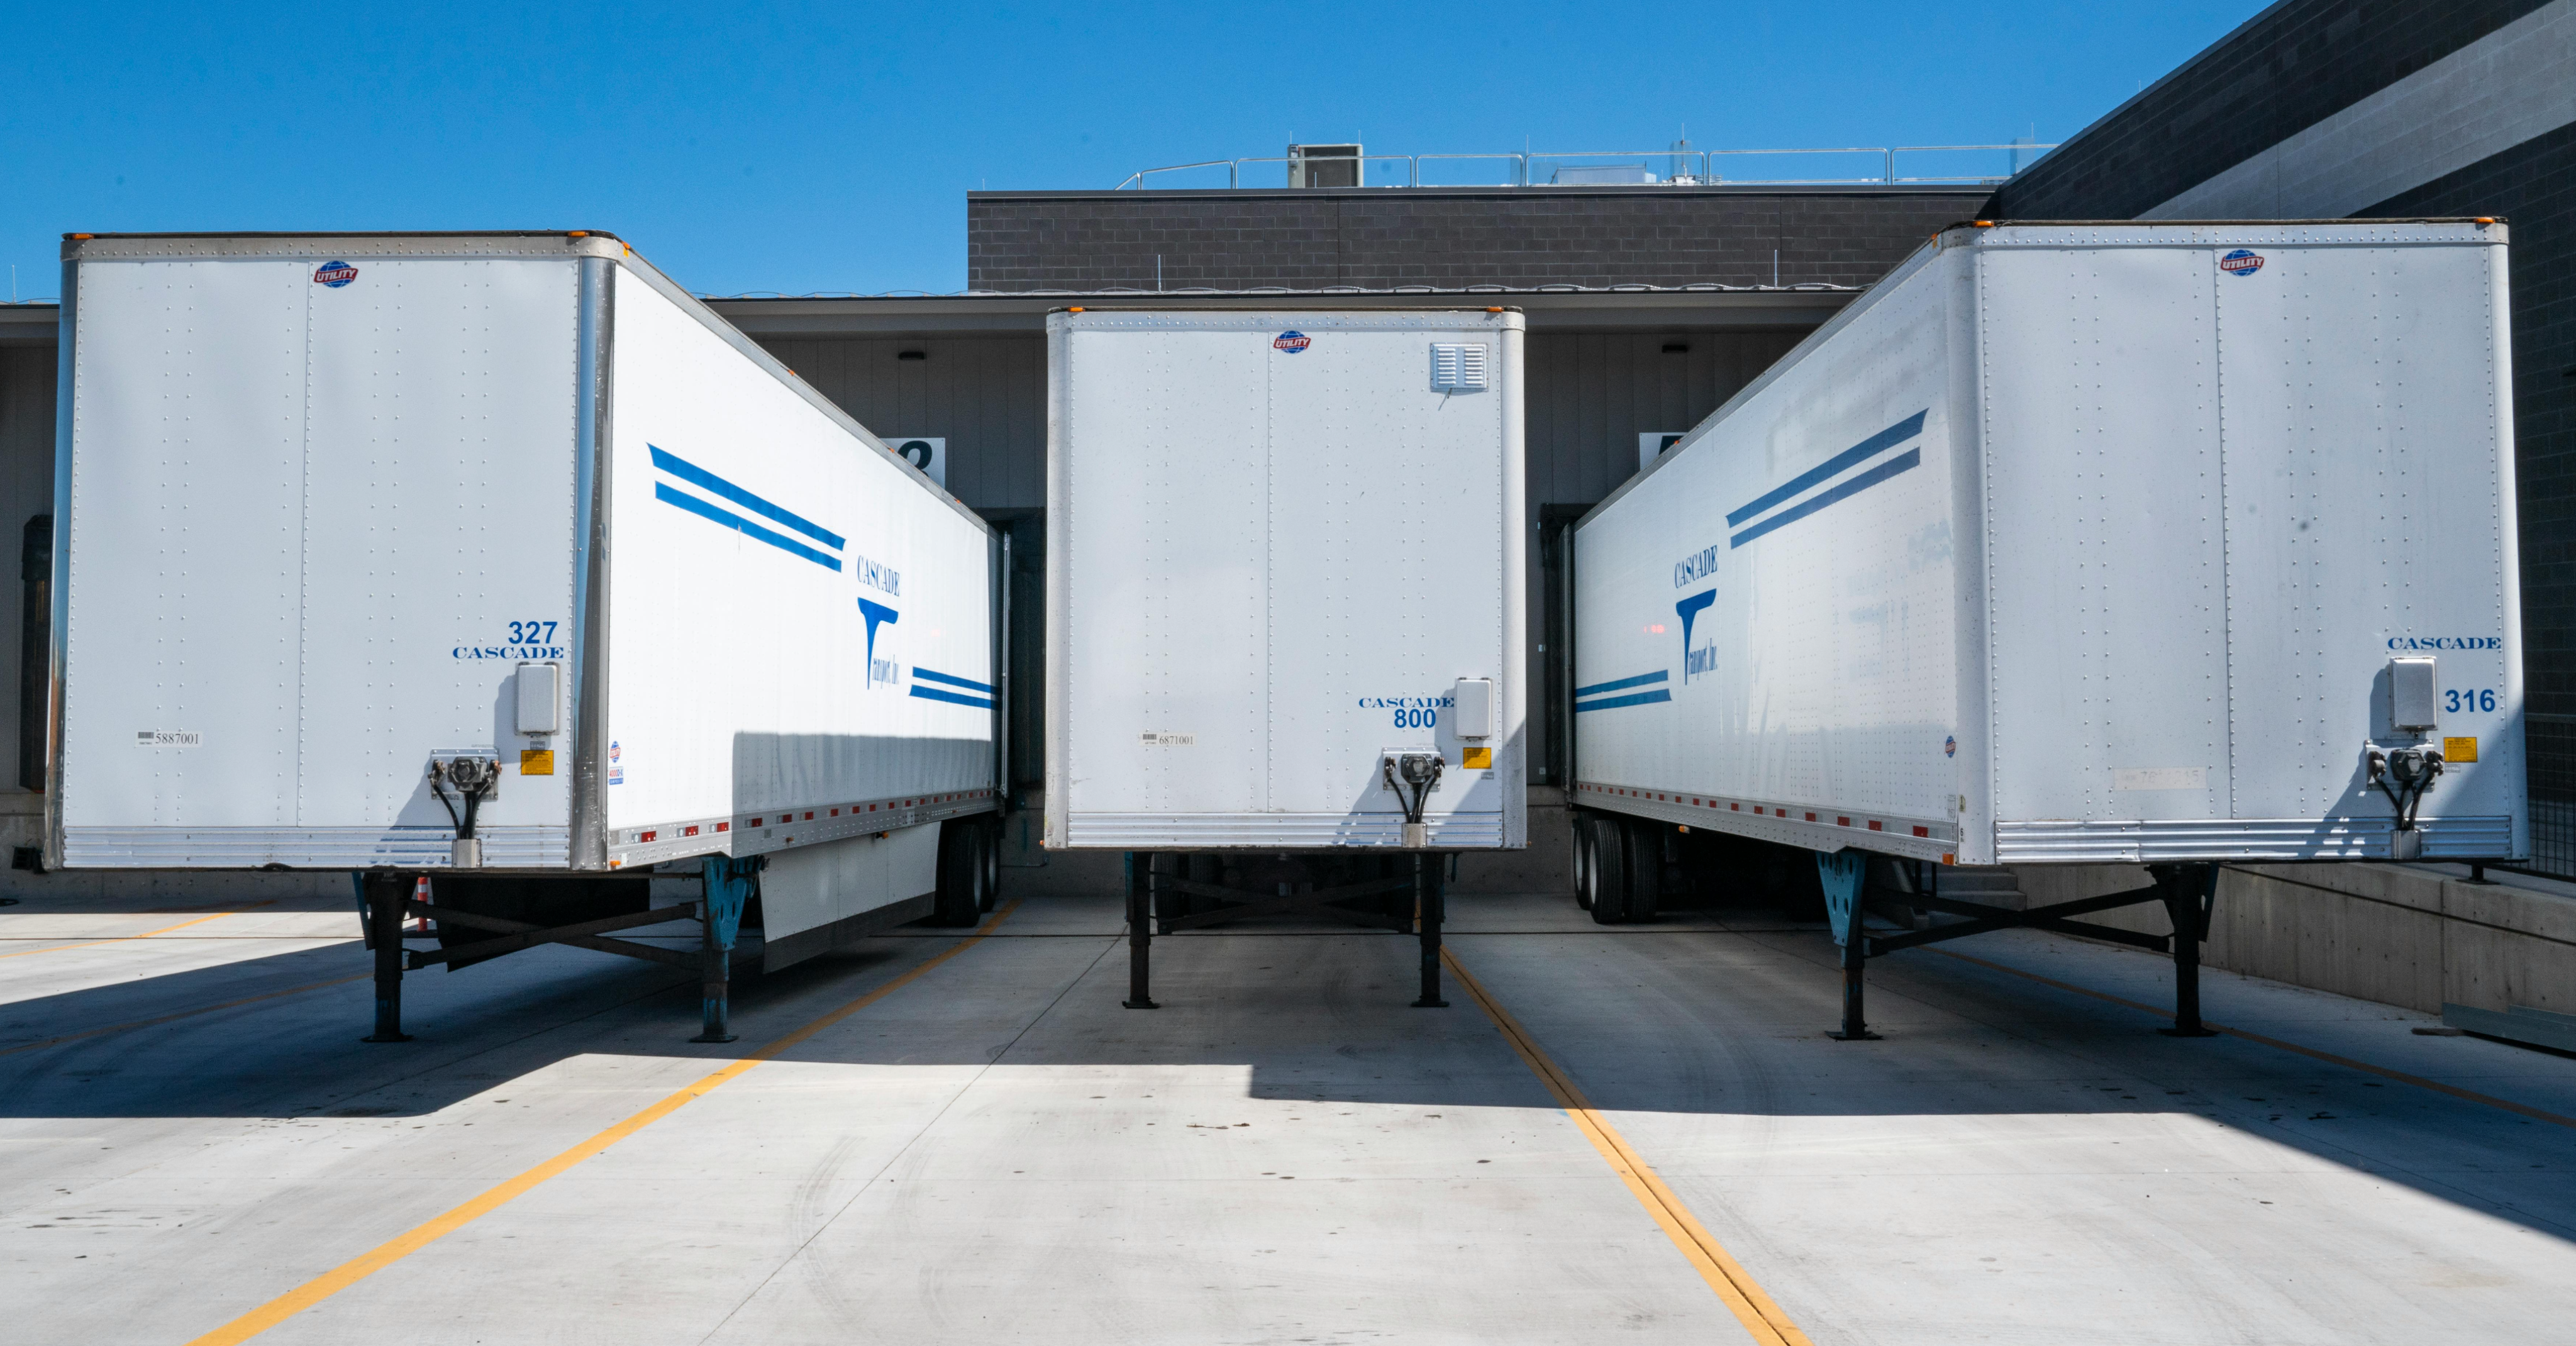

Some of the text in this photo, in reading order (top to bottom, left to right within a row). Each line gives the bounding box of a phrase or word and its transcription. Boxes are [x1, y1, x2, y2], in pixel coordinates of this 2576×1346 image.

[2222, 257, 2263, 269] UTILITY
[316, 269, 357, 282] UTILITY
[1275, 338, 1309, 348] UTILITY
[1674, 545, 1718, 589] CASCADE
[857, 555, 900, 598] CASCADE
[508, 621, 558, 645] 327
[2387, 637, 2502, 650] CASCADE
[452, 647, 564, 659] CASCADE
[1358, 698, 1455, 708] CASCADE
[2445, 689, 2496, 713] 316
[1394, 708, 1436, 728] 800
[155, 733, 199, 745] 5887001
[1159, 735, 1194, 745] 6871001
